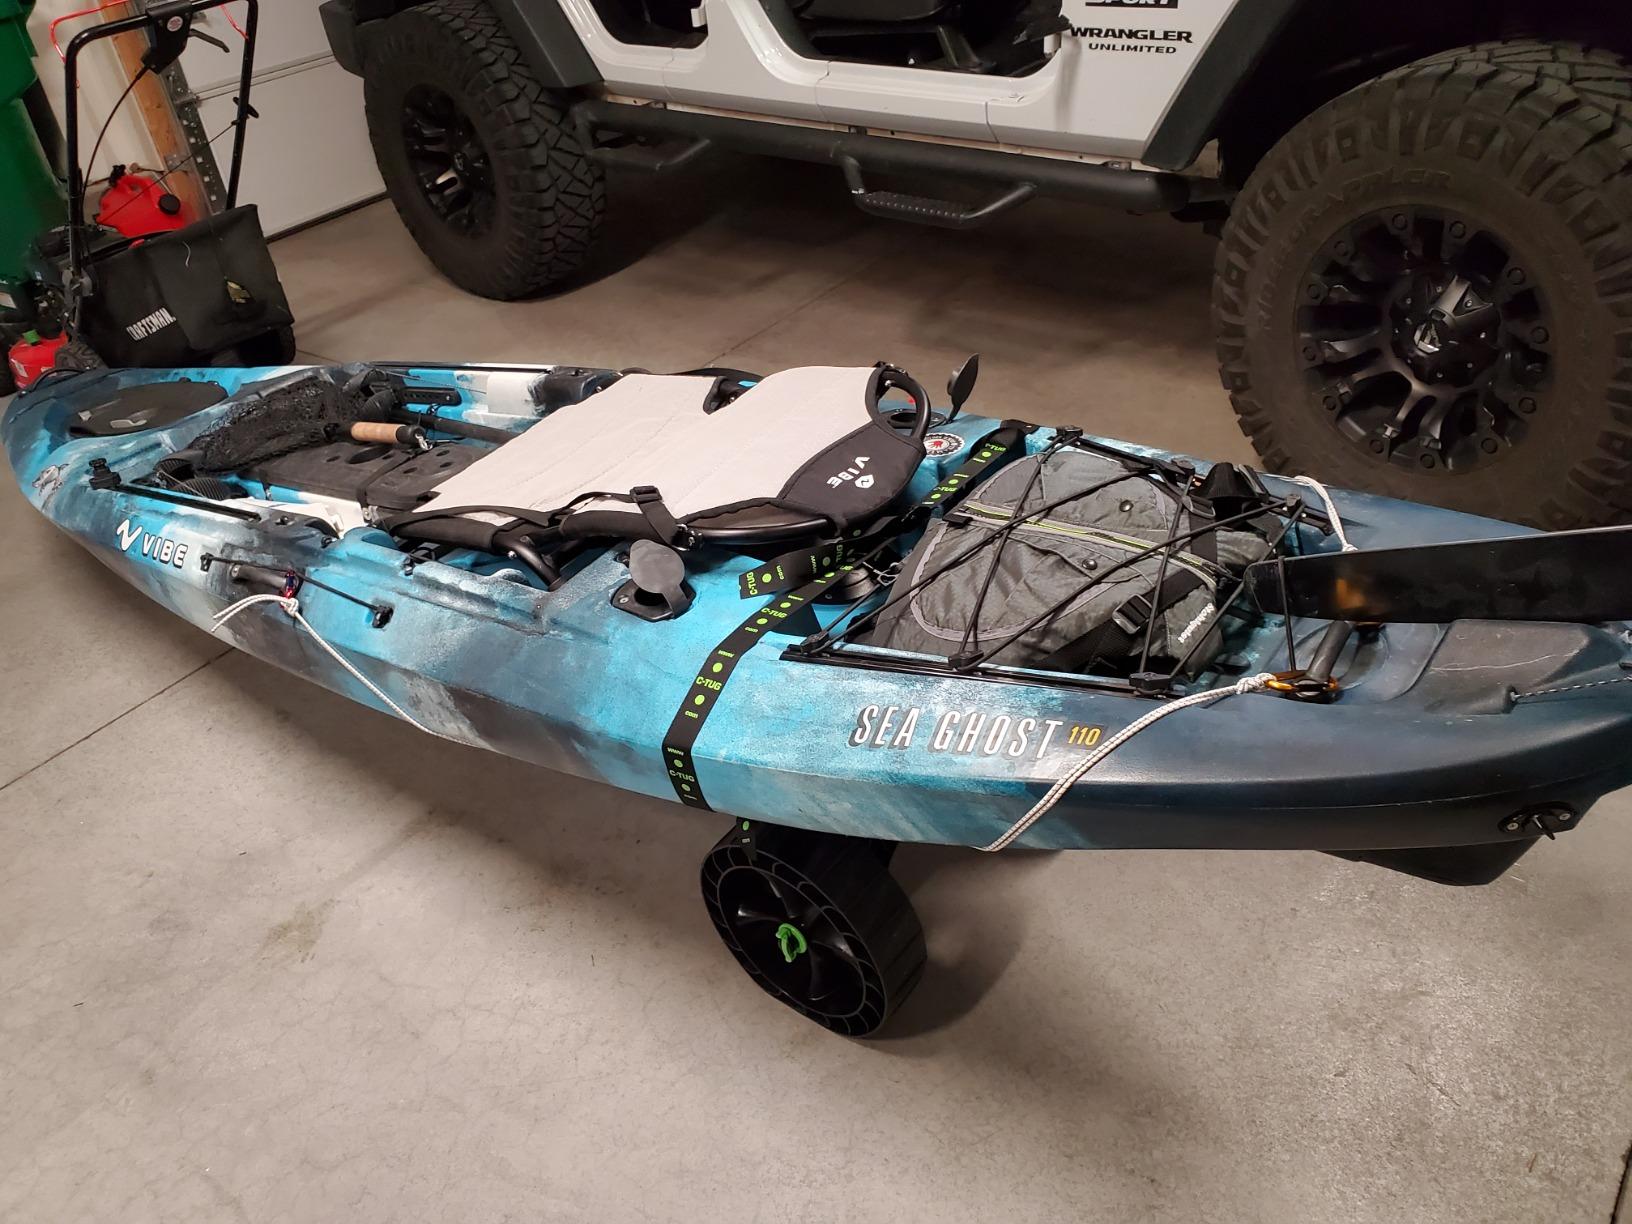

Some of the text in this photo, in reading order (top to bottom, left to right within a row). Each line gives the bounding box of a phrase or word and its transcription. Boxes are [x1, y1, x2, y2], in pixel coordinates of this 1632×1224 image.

[1070, 27, 1193, 43] WRANGLER
[1088, 43, 1177, 54] UNLIMITED
[126, 307, 174, 341] CRAFTSMAN
[826, 456, 870, 488] VIBE
[143, 532, 189, 568] VIBE
[746, 572, 758, 595] C-TUG
[760, 607, 787, 618] C-TUG
[696, 676, 722, 691] C-TUG
[851, 704, 1101, 759] SEA GHOST 110
[669, 769, 695, 782] C-TUG
